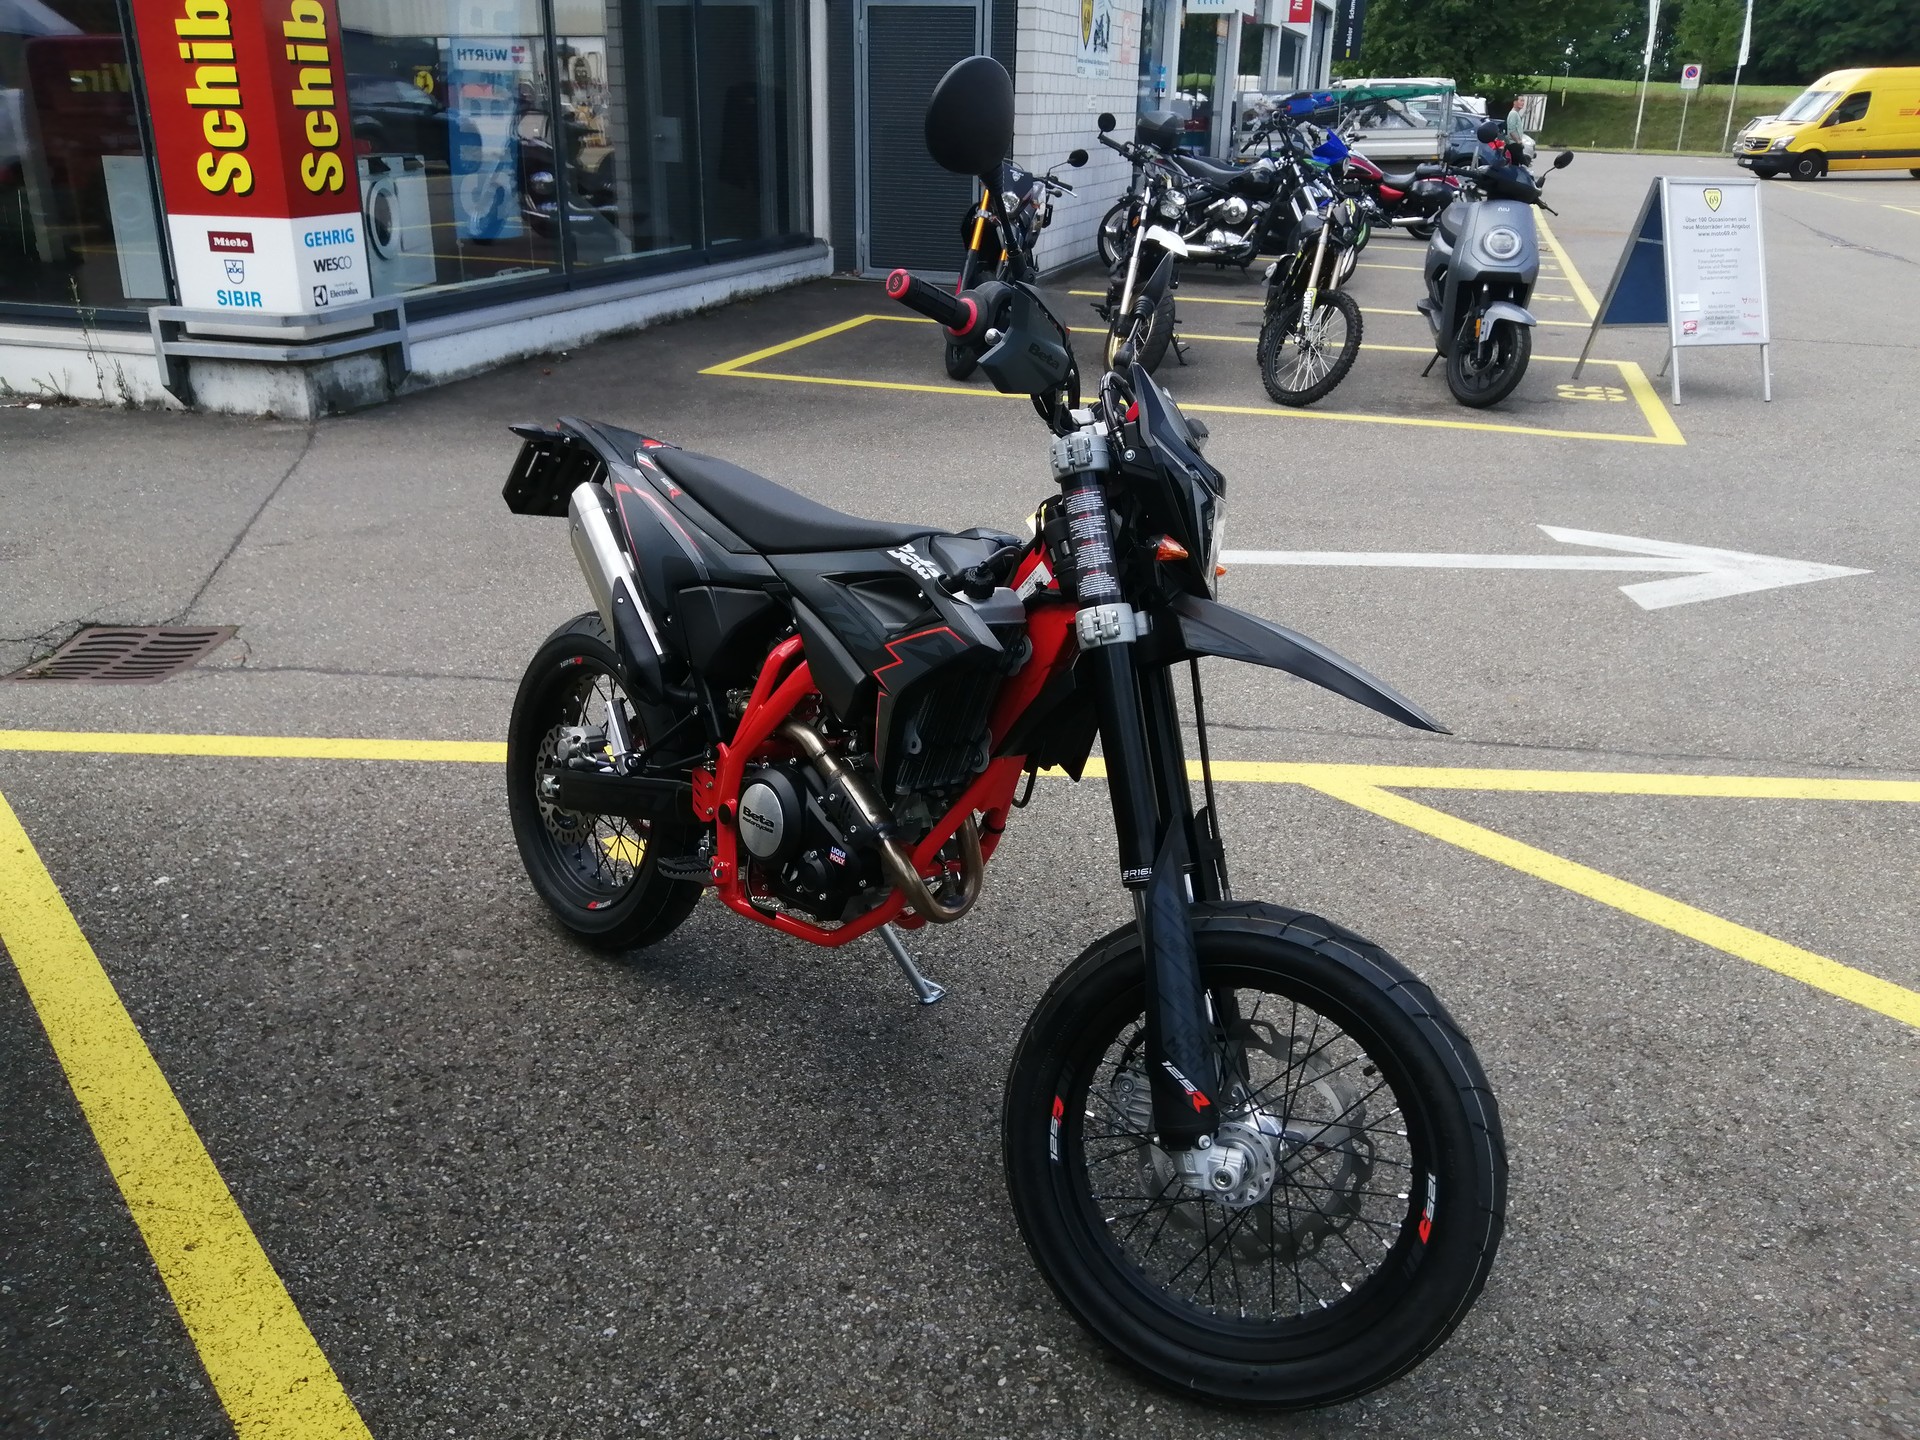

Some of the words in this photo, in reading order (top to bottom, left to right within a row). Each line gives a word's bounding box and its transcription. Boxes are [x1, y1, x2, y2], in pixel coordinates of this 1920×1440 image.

[174, 0, 254, 195] Schib
[282, 0, 345, 194] Schib
[213, 237, 249, 248] Miele
[304, 228, 355, 248] GEHRIG
[313, 255, 352, 273] WESCO
[216, 289, 263, 308] SIBIR
[330, 287, 359, 299] Electrolux
[1028, 342, 1060, 370] Beta
[743, 805, 775, 828] Beta
[829, 852, 846, 867] MOLY
[831, 845, 847, 858] LIQUI
[1161, 1060, 1211, 1114] 125R
[1049, 1094, 1065, 1161] 125R
[1418, 1172, 1436, 1245] 125R
